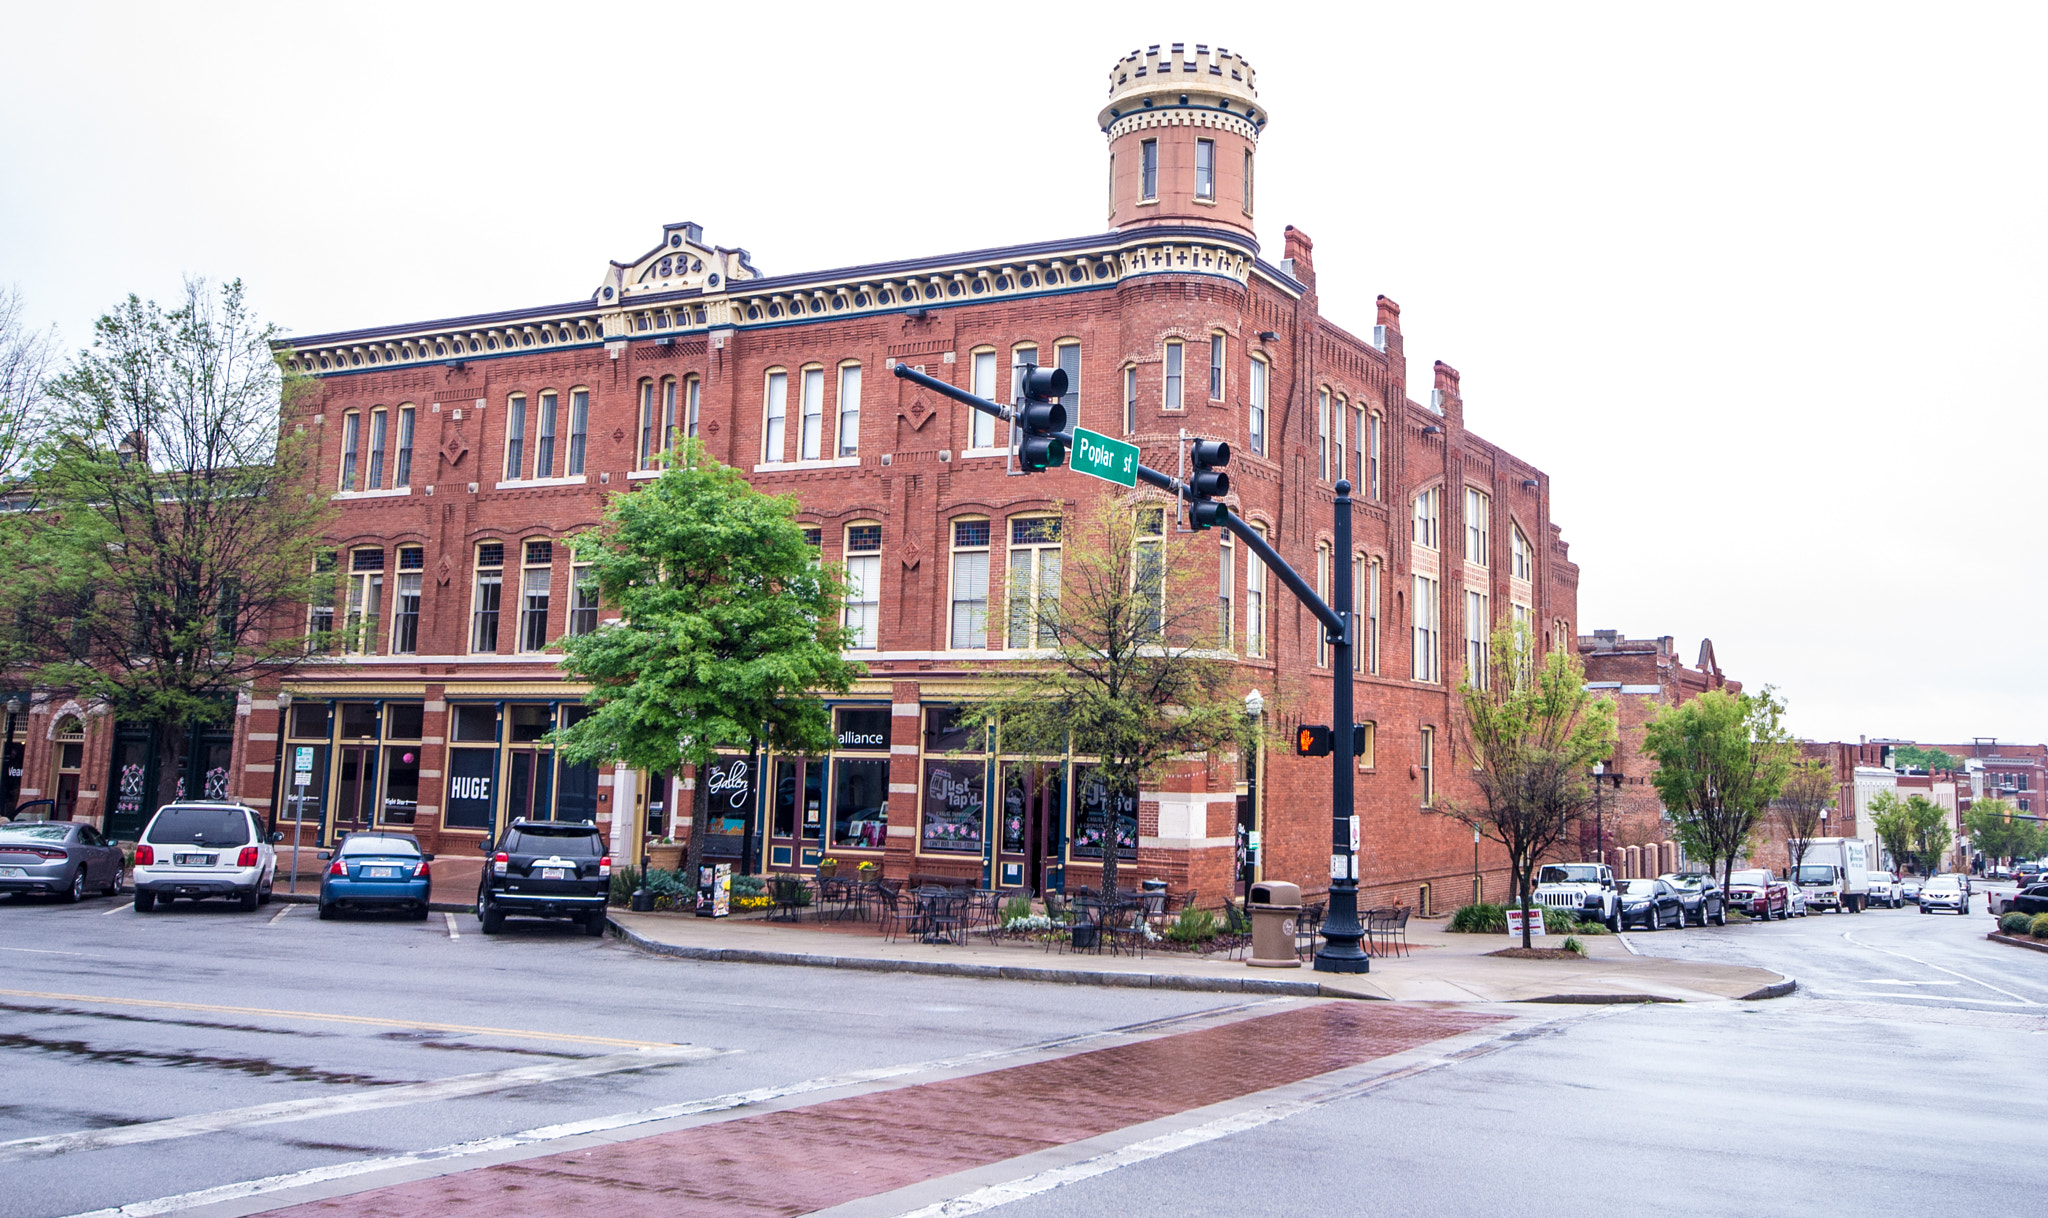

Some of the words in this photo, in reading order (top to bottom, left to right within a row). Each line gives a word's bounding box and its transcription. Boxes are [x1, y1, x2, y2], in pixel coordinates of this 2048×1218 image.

[651, 254, 702, 279] 1884
[1079, 437, 1114, 468] Poplar
[1123, 453, 1132, 474] st
[838, 731, 883, 745] alliance
[451, 776, 490, 799] HUGE
[708, 760, 748, 809] Gallery
[936, 777, 970, 800] Just
[948, 791, 978, 809] Tap'd
